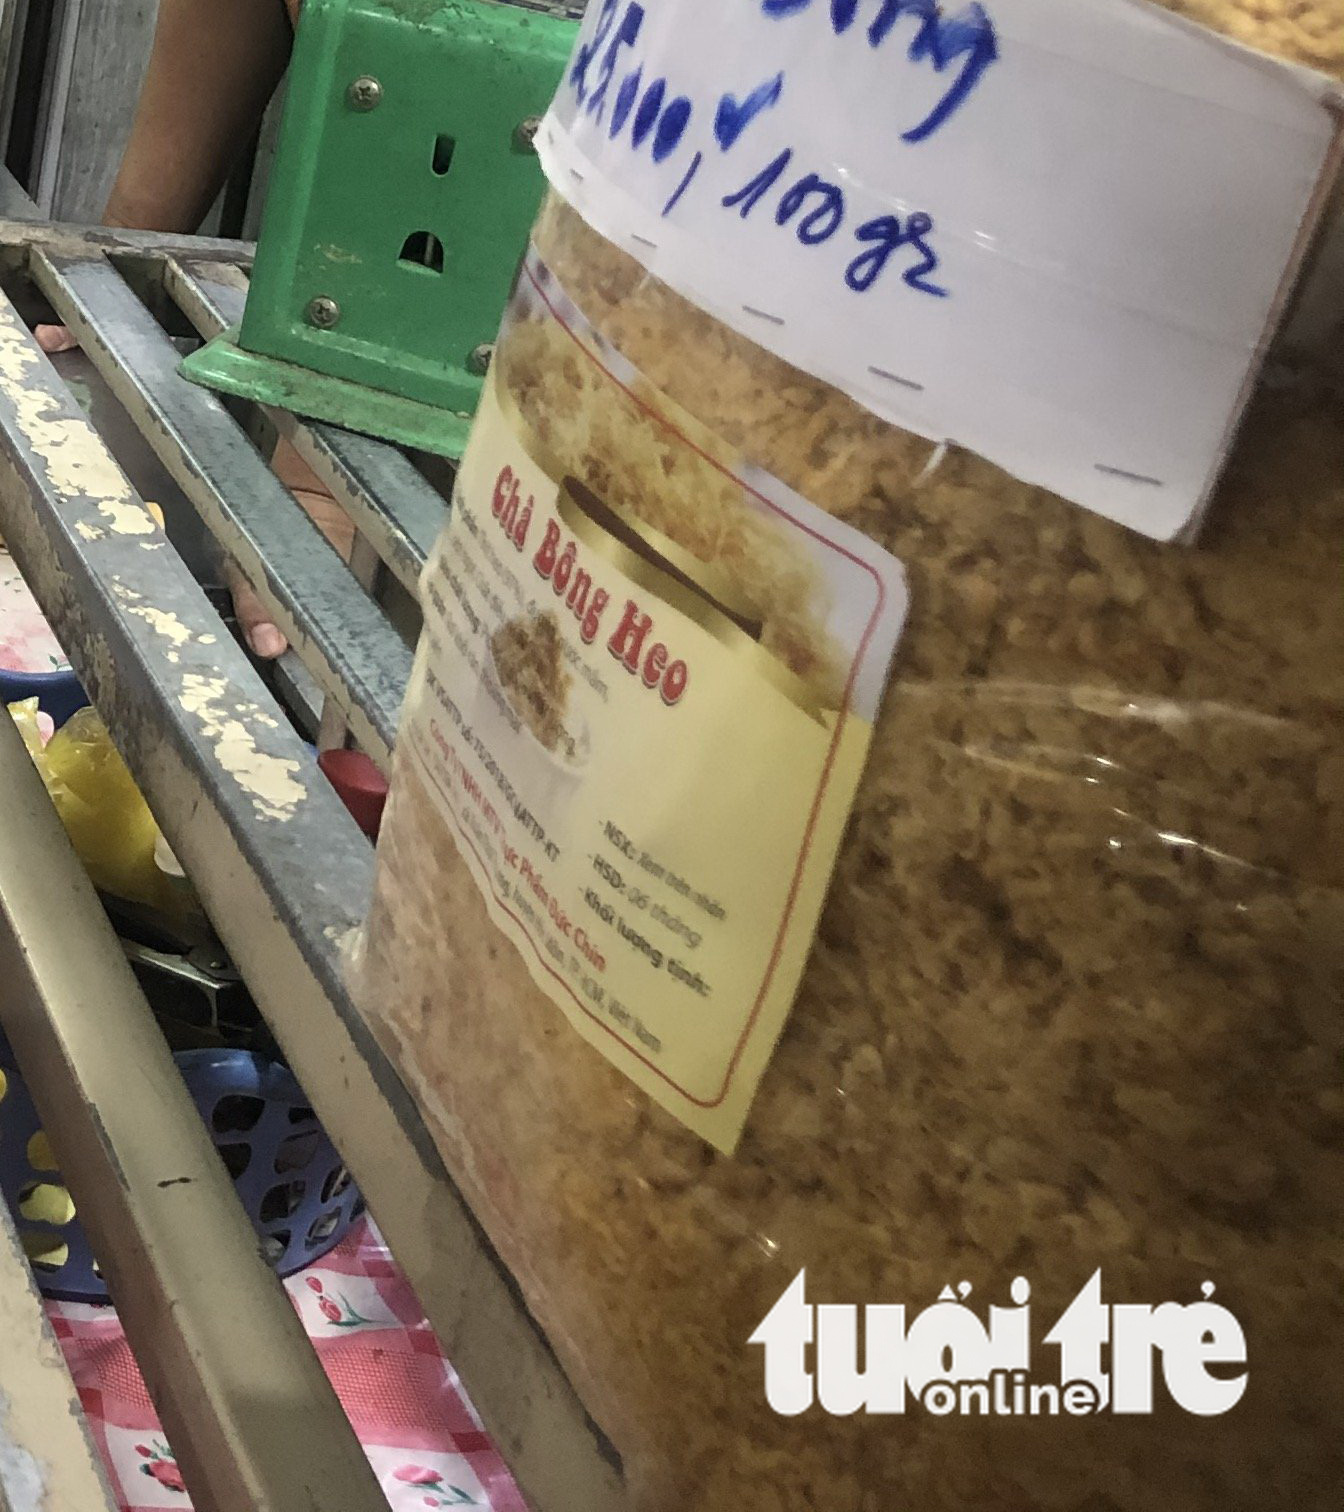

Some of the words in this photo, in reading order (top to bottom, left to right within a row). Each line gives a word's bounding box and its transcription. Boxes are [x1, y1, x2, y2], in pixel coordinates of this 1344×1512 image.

[492, 464, 535, 552] Chả
[532, 517, 610, 645] Bông
[607, 599, 688, 707] Heo
[592, 853, 627, 895] HSD:
